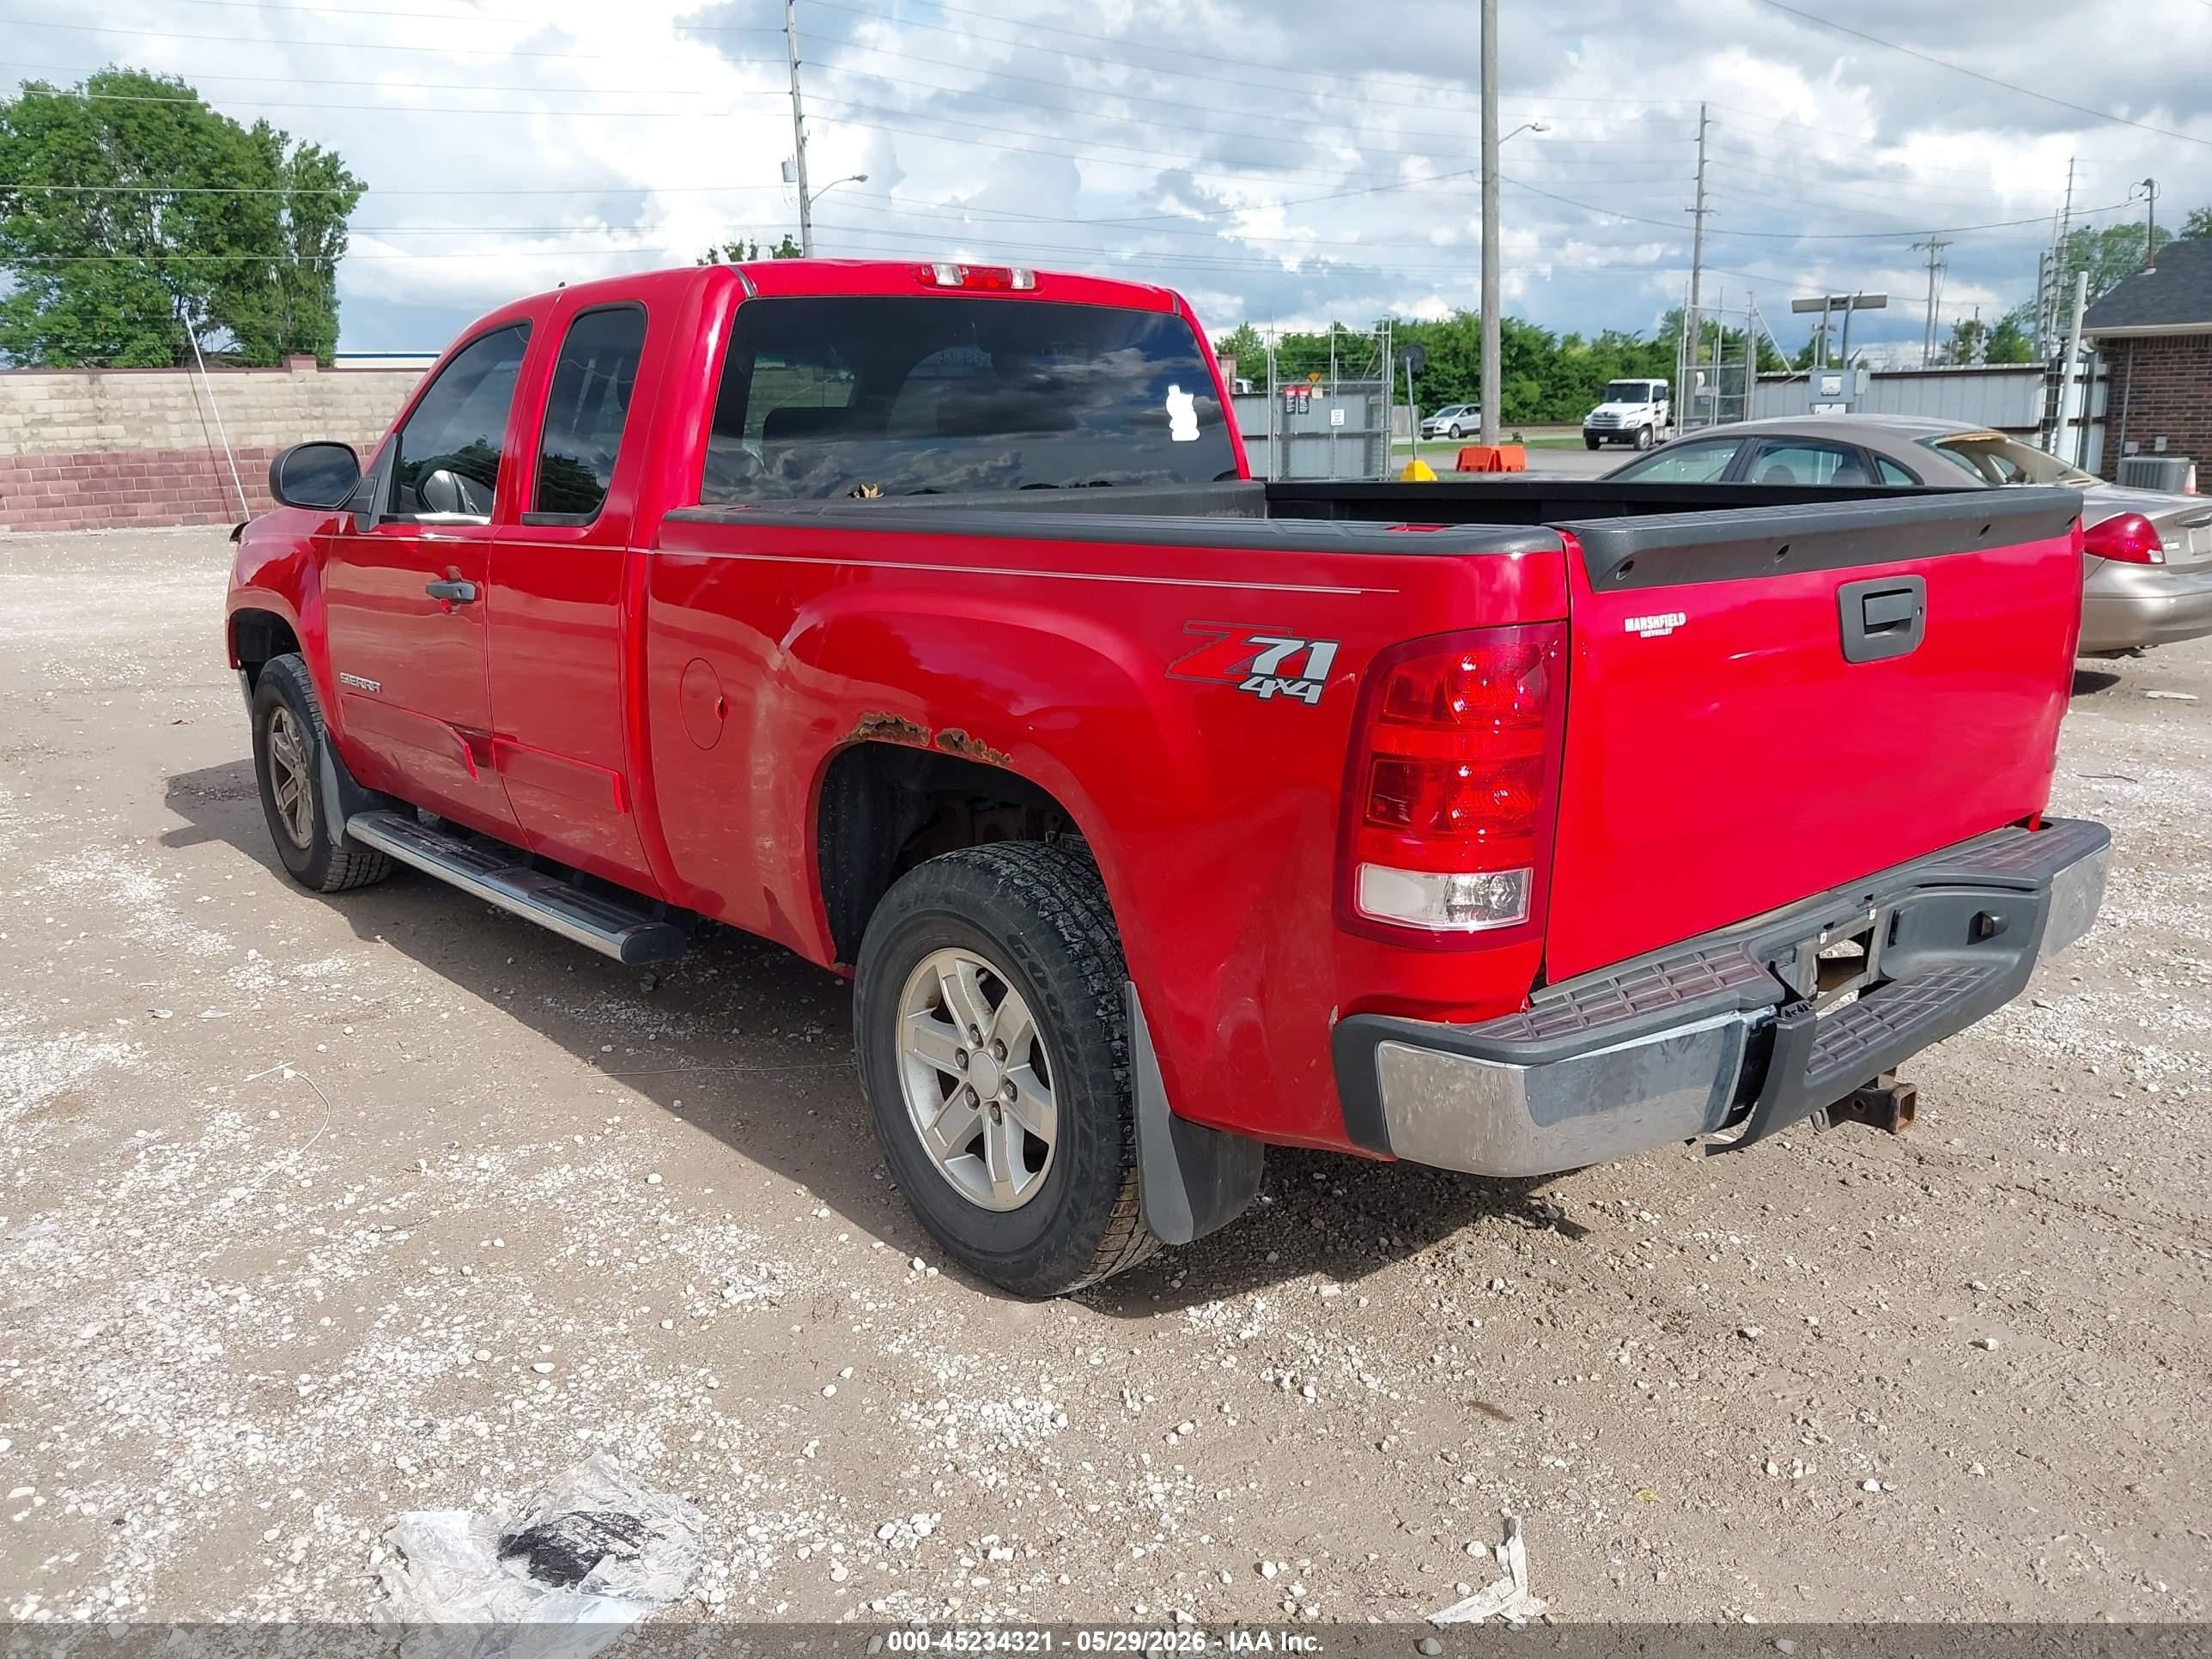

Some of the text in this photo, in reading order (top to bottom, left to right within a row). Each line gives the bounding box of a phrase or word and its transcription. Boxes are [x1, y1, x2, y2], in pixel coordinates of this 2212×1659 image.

[1625, 612, 1686, 632] MARSHFIELD
[1165, 620, 1341, 684] Z71
[340, 672, 381, 693] SIERRA
